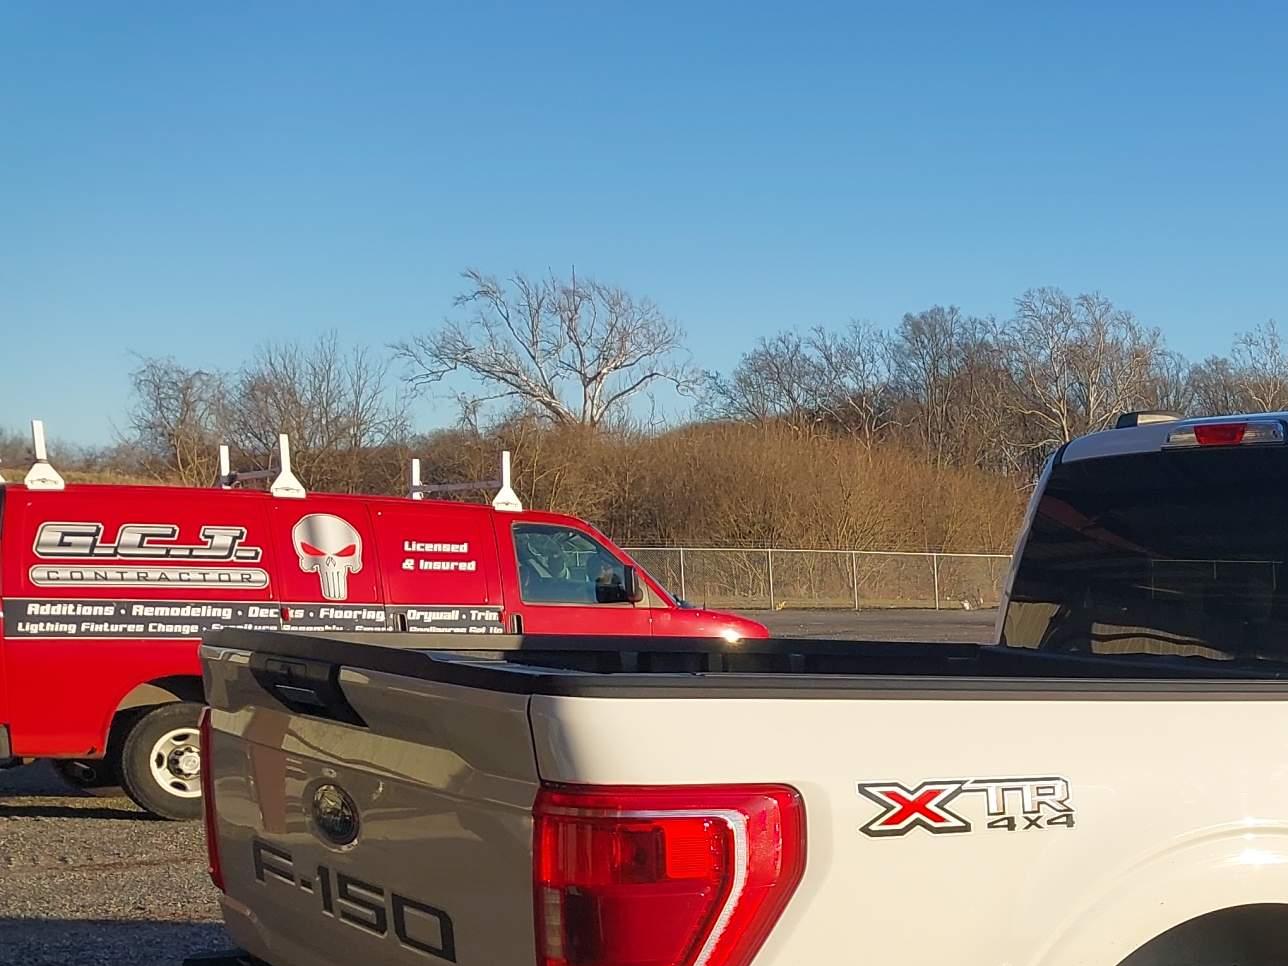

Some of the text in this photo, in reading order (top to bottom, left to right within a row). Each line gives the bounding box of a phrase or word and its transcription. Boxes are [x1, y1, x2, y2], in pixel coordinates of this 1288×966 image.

[404, 541, 468, 552] Licensed
[402, 560, 476, 571] & Insured
[47, 570, 254, 584] CONTRACTOR
[27, 603, 115, 616] Additions
[132, 605, 232, 619] Remodeling
[320, 608, 386, 621] Flooring
[407, 609, 459, 622] Drywall
[17, 622, 76, 634] Ligthing
[81, 622, 144, 632] Fixtures
[148, 623, 199, 634] Change
[253, 839, 457, 965] F-150
